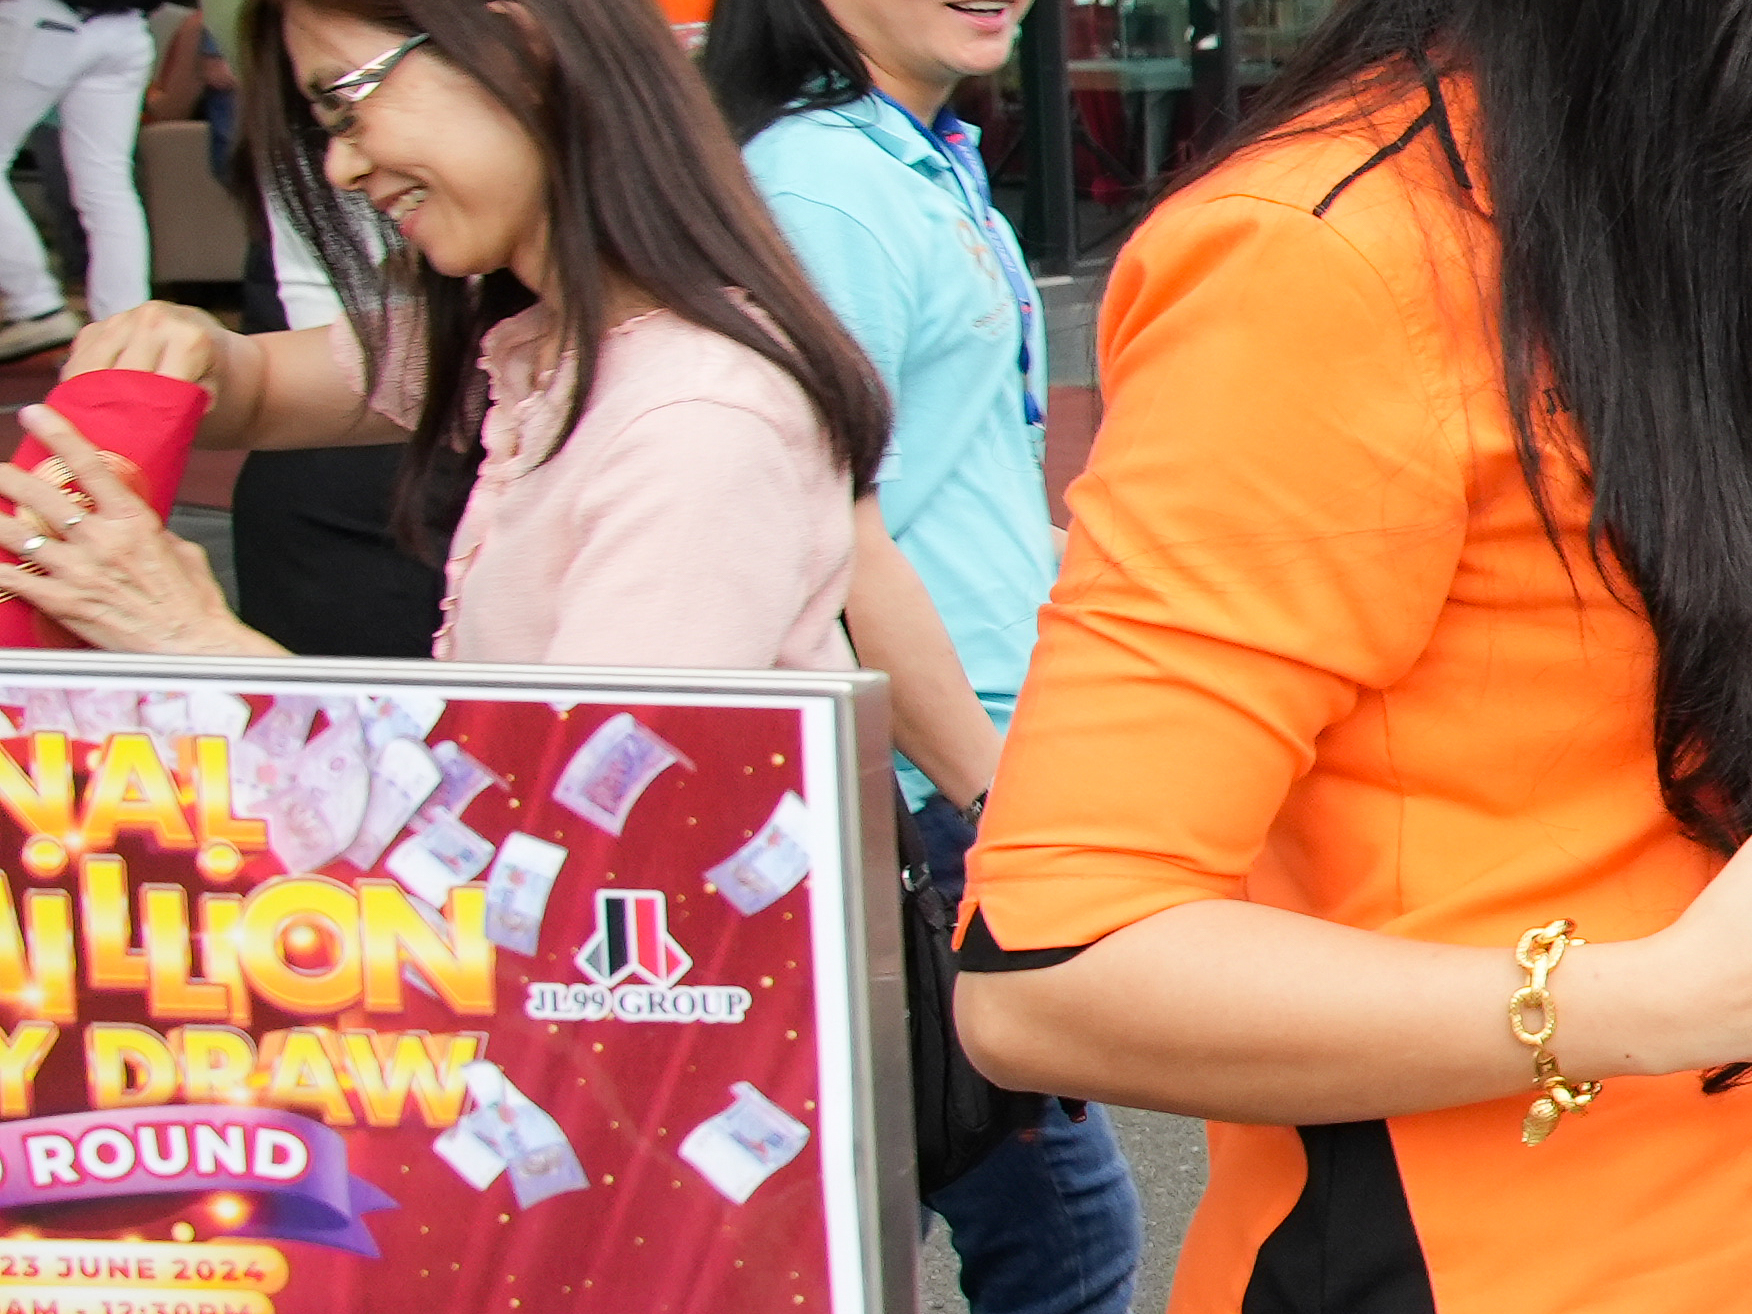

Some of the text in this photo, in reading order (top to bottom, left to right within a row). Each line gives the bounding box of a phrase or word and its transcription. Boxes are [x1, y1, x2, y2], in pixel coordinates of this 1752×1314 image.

[0, 730, 269, 851] NAL
[535, 988, 743, 1016] JL99 GROUP
[85, 1022, 489, 1128] DRAW
[24, 1124, 308, 1186] ROUND
[0, 1255, 267, 1283] 23 JUNE 2024
